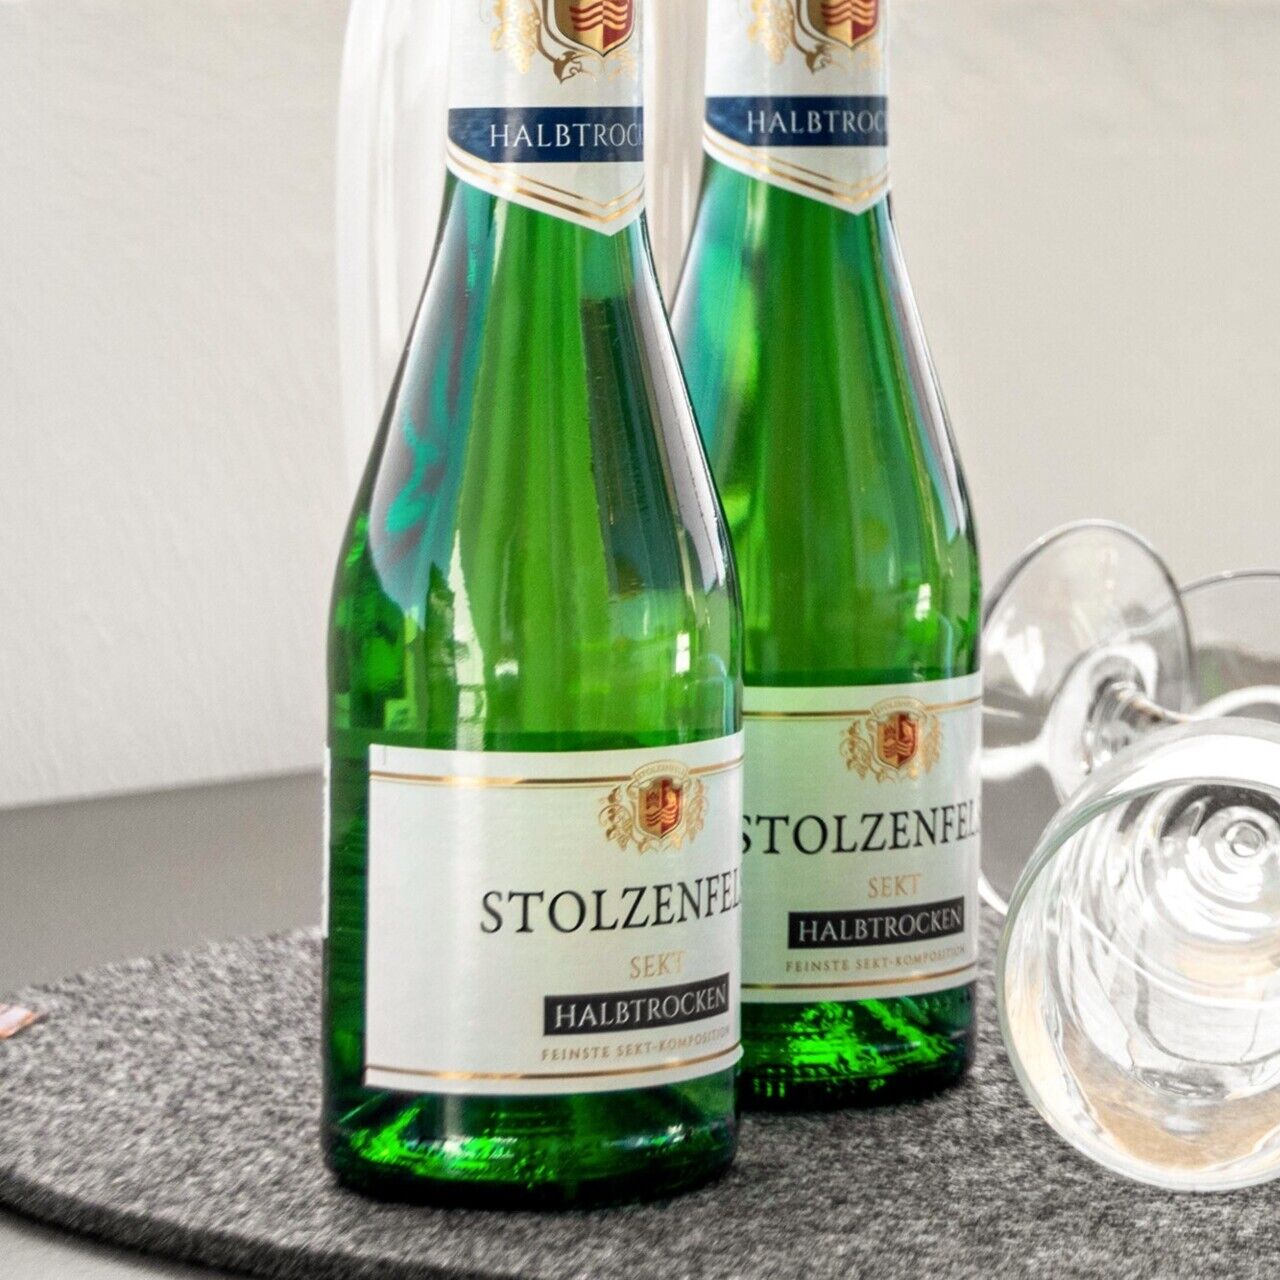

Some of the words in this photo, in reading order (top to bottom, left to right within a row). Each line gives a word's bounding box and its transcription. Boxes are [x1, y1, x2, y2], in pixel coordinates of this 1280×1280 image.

[490, 122, 641, 148] HALBTROC
[867, 873, 921, 899] SEKT
[798, 906, 962, 943] HALBTROCKEN
[629, 950, 687, 980] SEKT
[785, 958, 847, 973] FEINSTE
[553, 983, 726, 1029] HALBTROCKEN
[541, 1045, 610, 1061] FEINSTE
